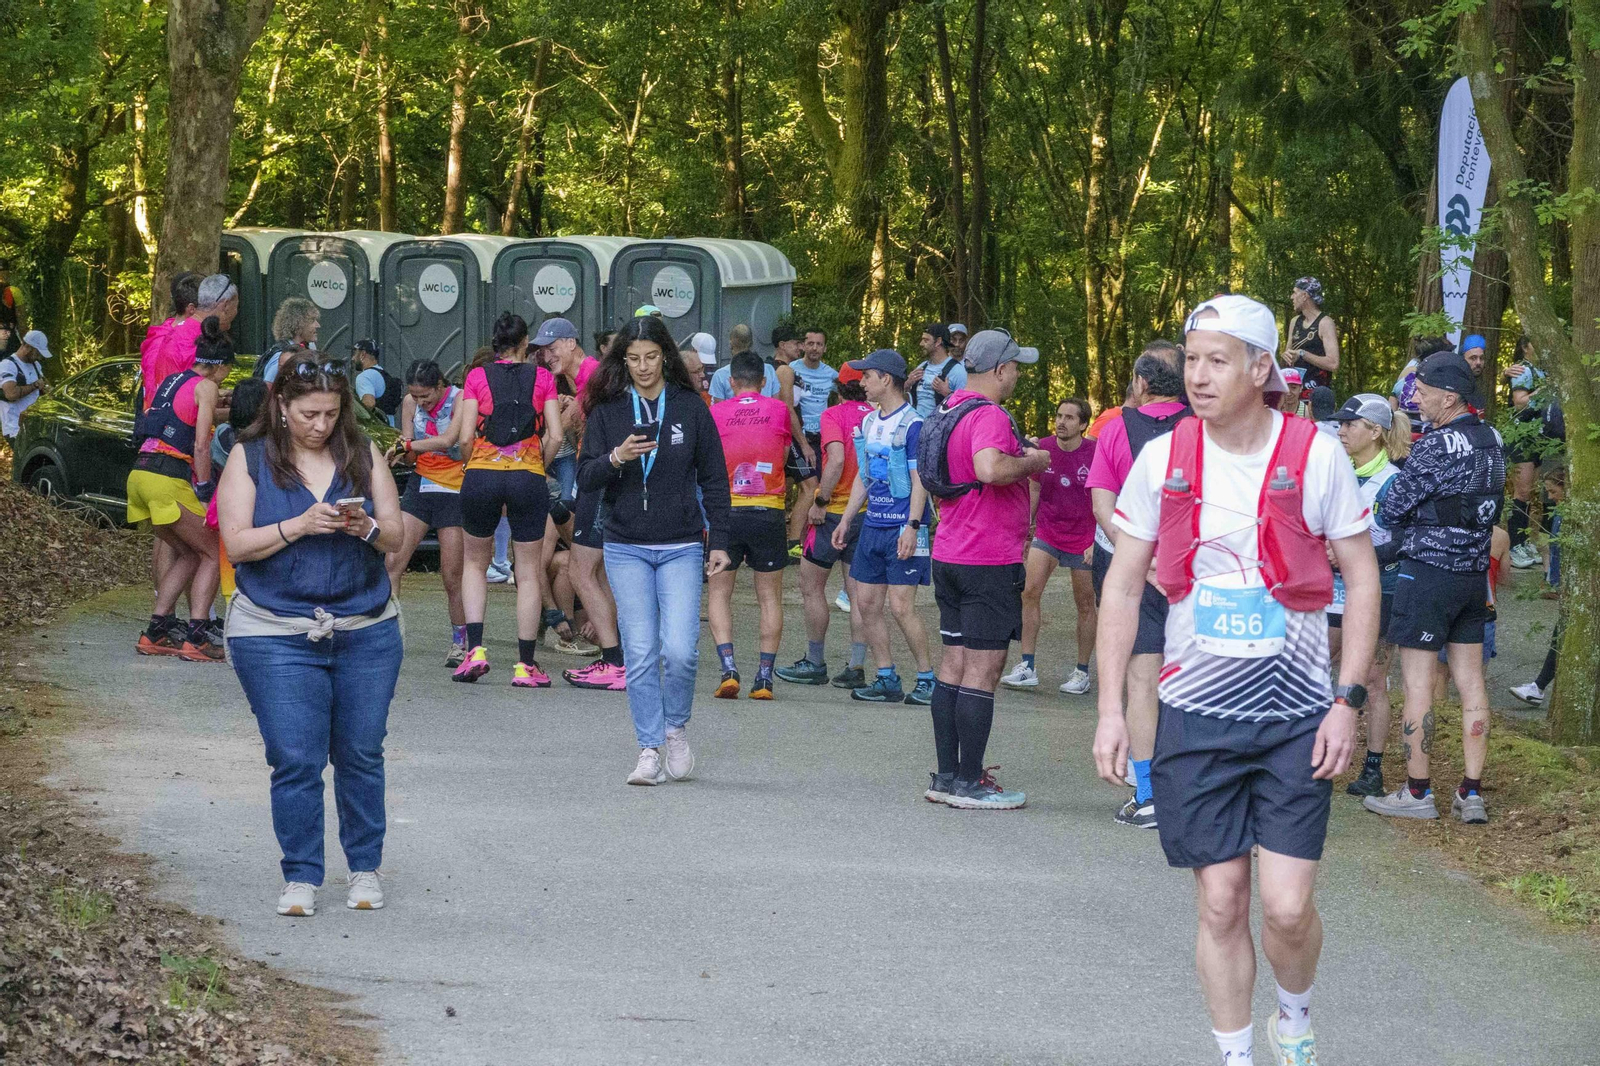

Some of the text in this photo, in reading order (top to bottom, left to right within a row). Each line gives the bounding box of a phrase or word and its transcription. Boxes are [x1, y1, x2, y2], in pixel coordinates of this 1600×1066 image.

[726, 416, 771, 427] TRAIL TEAM
[1213, 613, 1263, 635] 456
